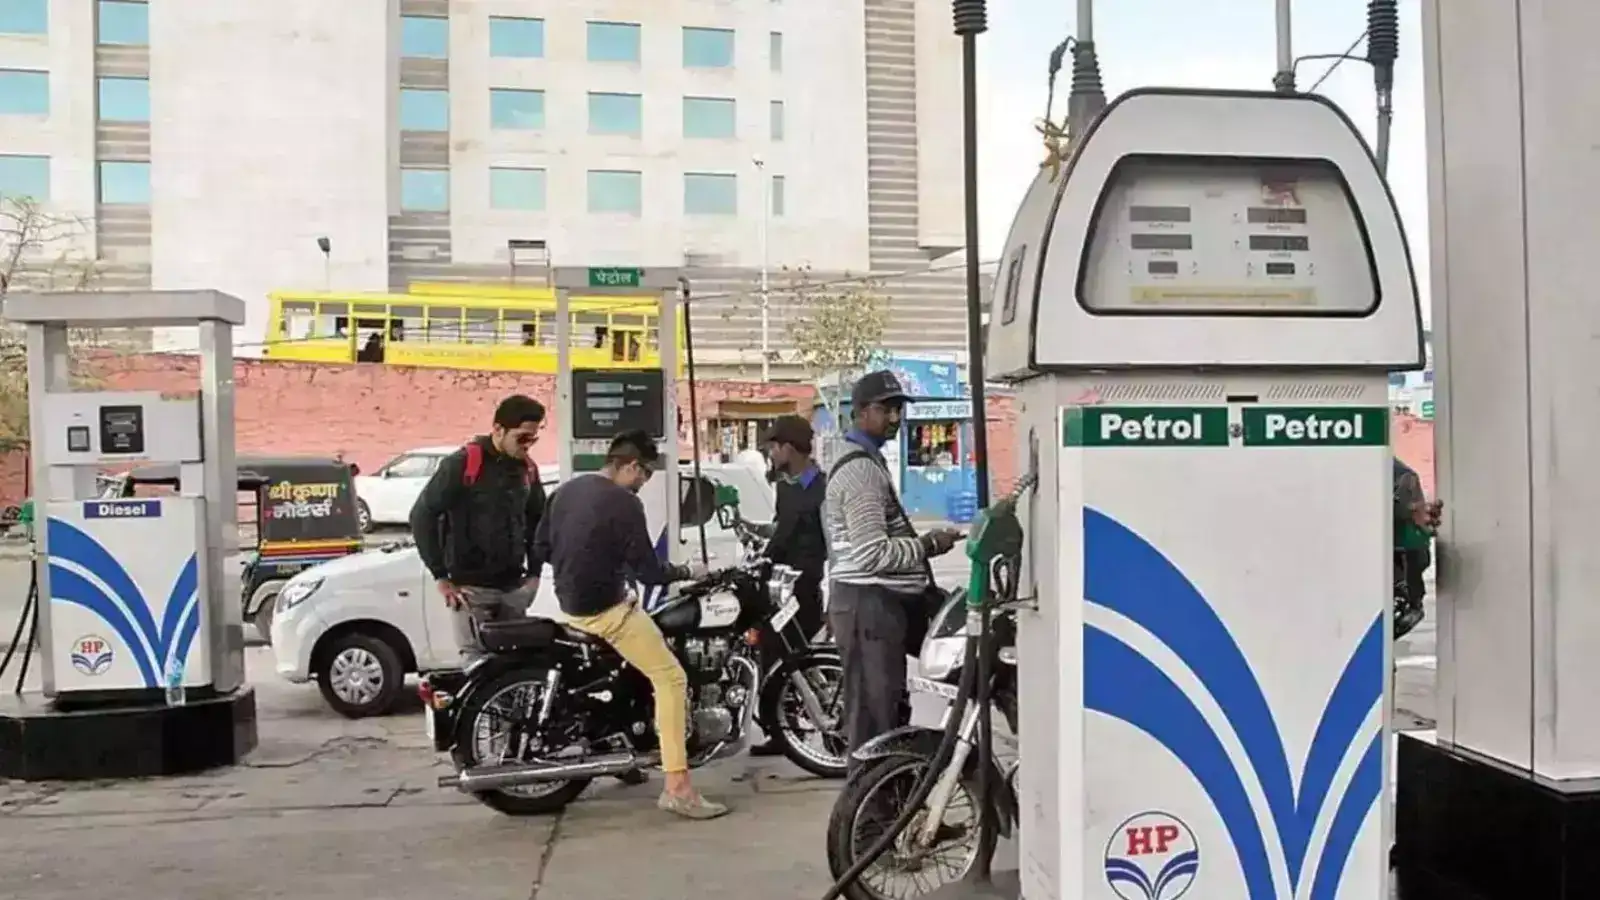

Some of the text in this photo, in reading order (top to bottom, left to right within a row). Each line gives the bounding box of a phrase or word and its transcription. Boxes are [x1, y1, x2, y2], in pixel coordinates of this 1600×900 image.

[1100, 414, 1202, 439] Petrol
[1265, 414, 1363, 439] Petrol
[98, 504, 147, 516] Diesel
[81, 641, 104, 654] HP
[1126, 825, 1179, 855] HP
